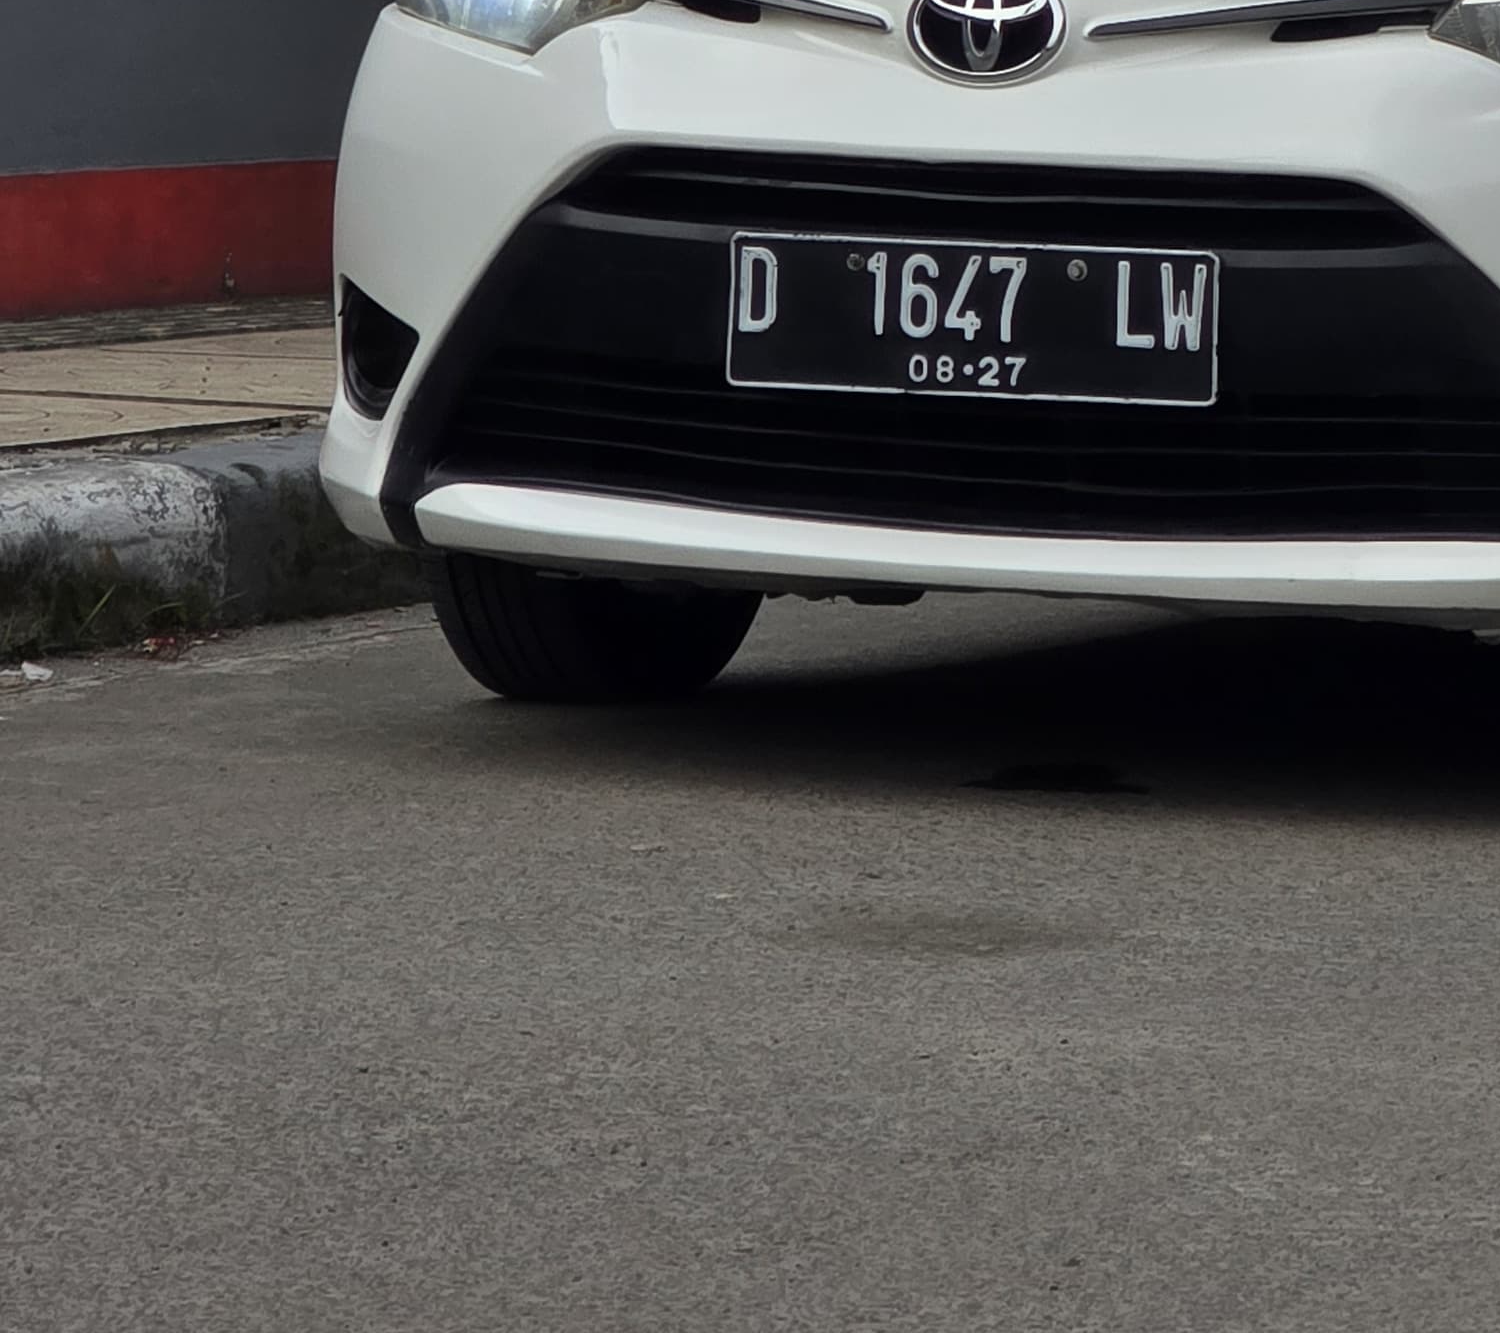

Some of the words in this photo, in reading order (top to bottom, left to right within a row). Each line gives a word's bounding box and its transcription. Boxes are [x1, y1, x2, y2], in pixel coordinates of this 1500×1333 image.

[737, 246, 778, 333] D
[866, 251, 1028, 343] 1647
[1115, 260, 1208, 351] LW
